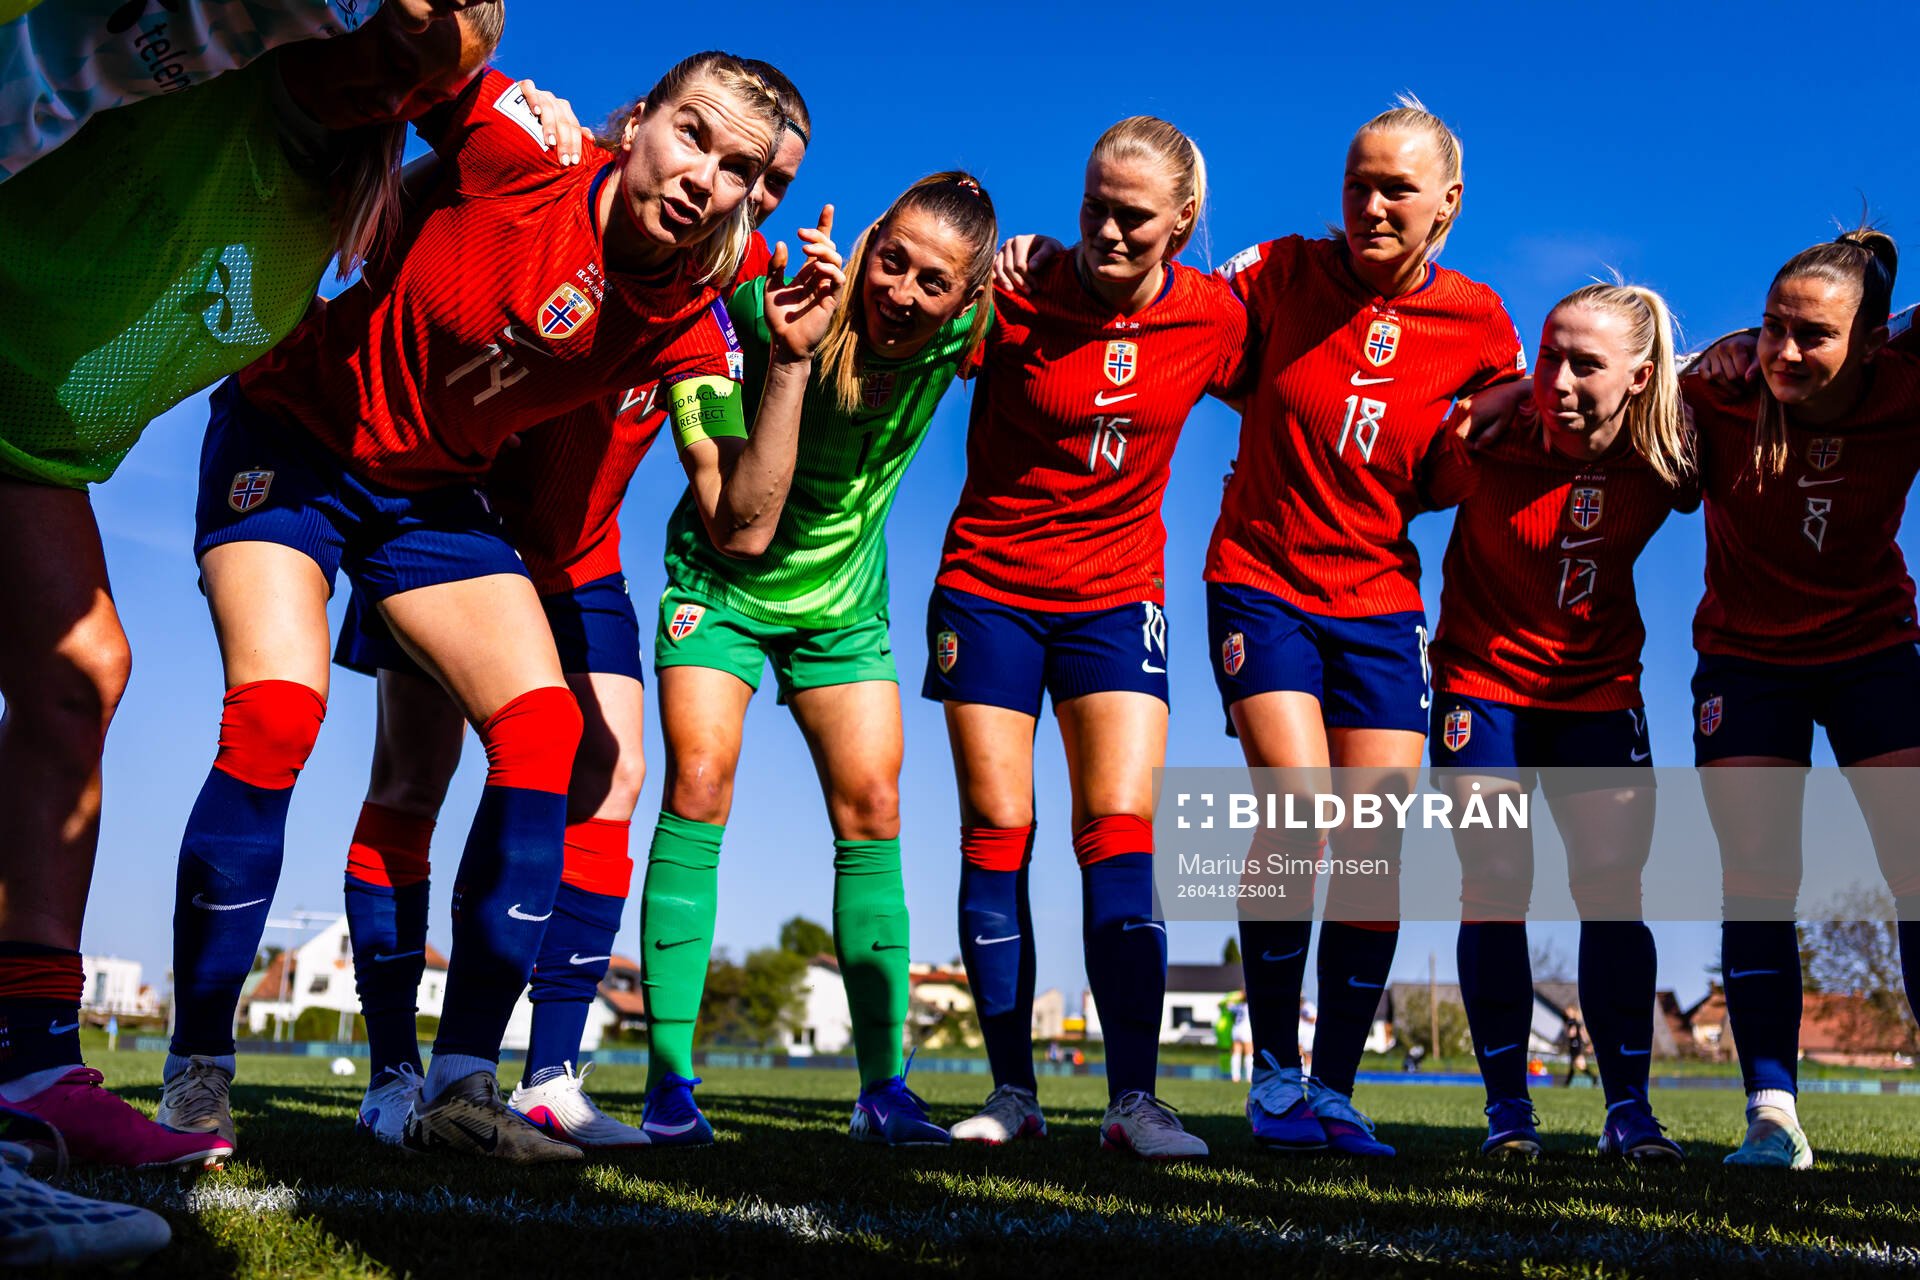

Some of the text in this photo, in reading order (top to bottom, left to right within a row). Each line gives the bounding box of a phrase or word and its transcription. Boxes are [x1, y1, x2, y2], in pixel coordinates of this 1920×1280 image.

[680, 409, 725, 428] RESPECT
[687, 391, 729, 404] RACISM
[856, 432, 872, 476] 1
[1087, 415, 1132, 476] 16
[1336, 394, 1387, 464] 18
[1803, 496, 1832, 552] 8
[1558, 557, 1598, 609] 13
